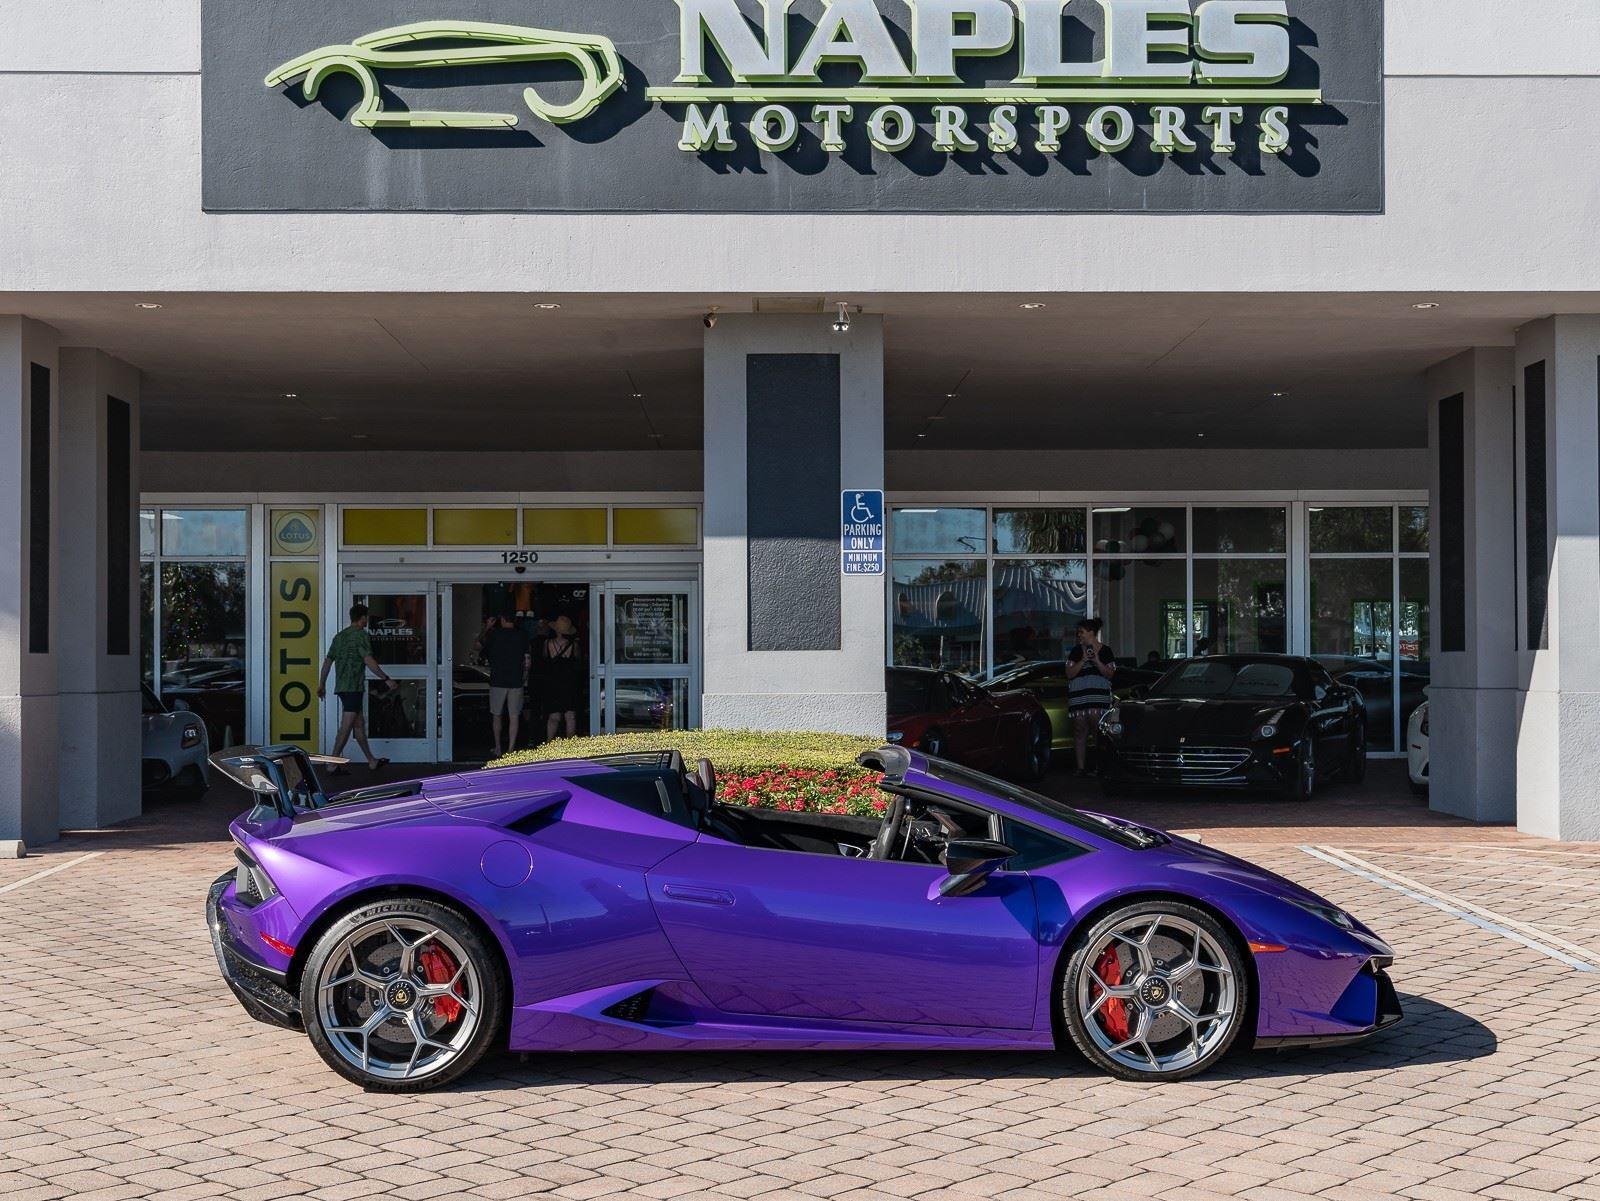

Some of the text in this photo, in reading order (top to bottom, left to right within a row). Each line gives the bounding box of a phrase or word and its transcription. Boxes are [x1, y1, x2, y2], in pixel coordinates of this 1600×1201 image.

[672, 0, 1290, 84] NAPLES
[678, 103, 1290, 154] MOTORSPORTS
[280, 532, 311, 540] LOTUS
[843, 523, 882, 536] PARKING
[850, 537, 875, 549] ONLY
[501, 551, 539, 564] 1250
[848, 553, 878, 562] MINIMUM
[846, 563, 880, 572] FINE $250
[279, 576, 312, 741] LOTUS
